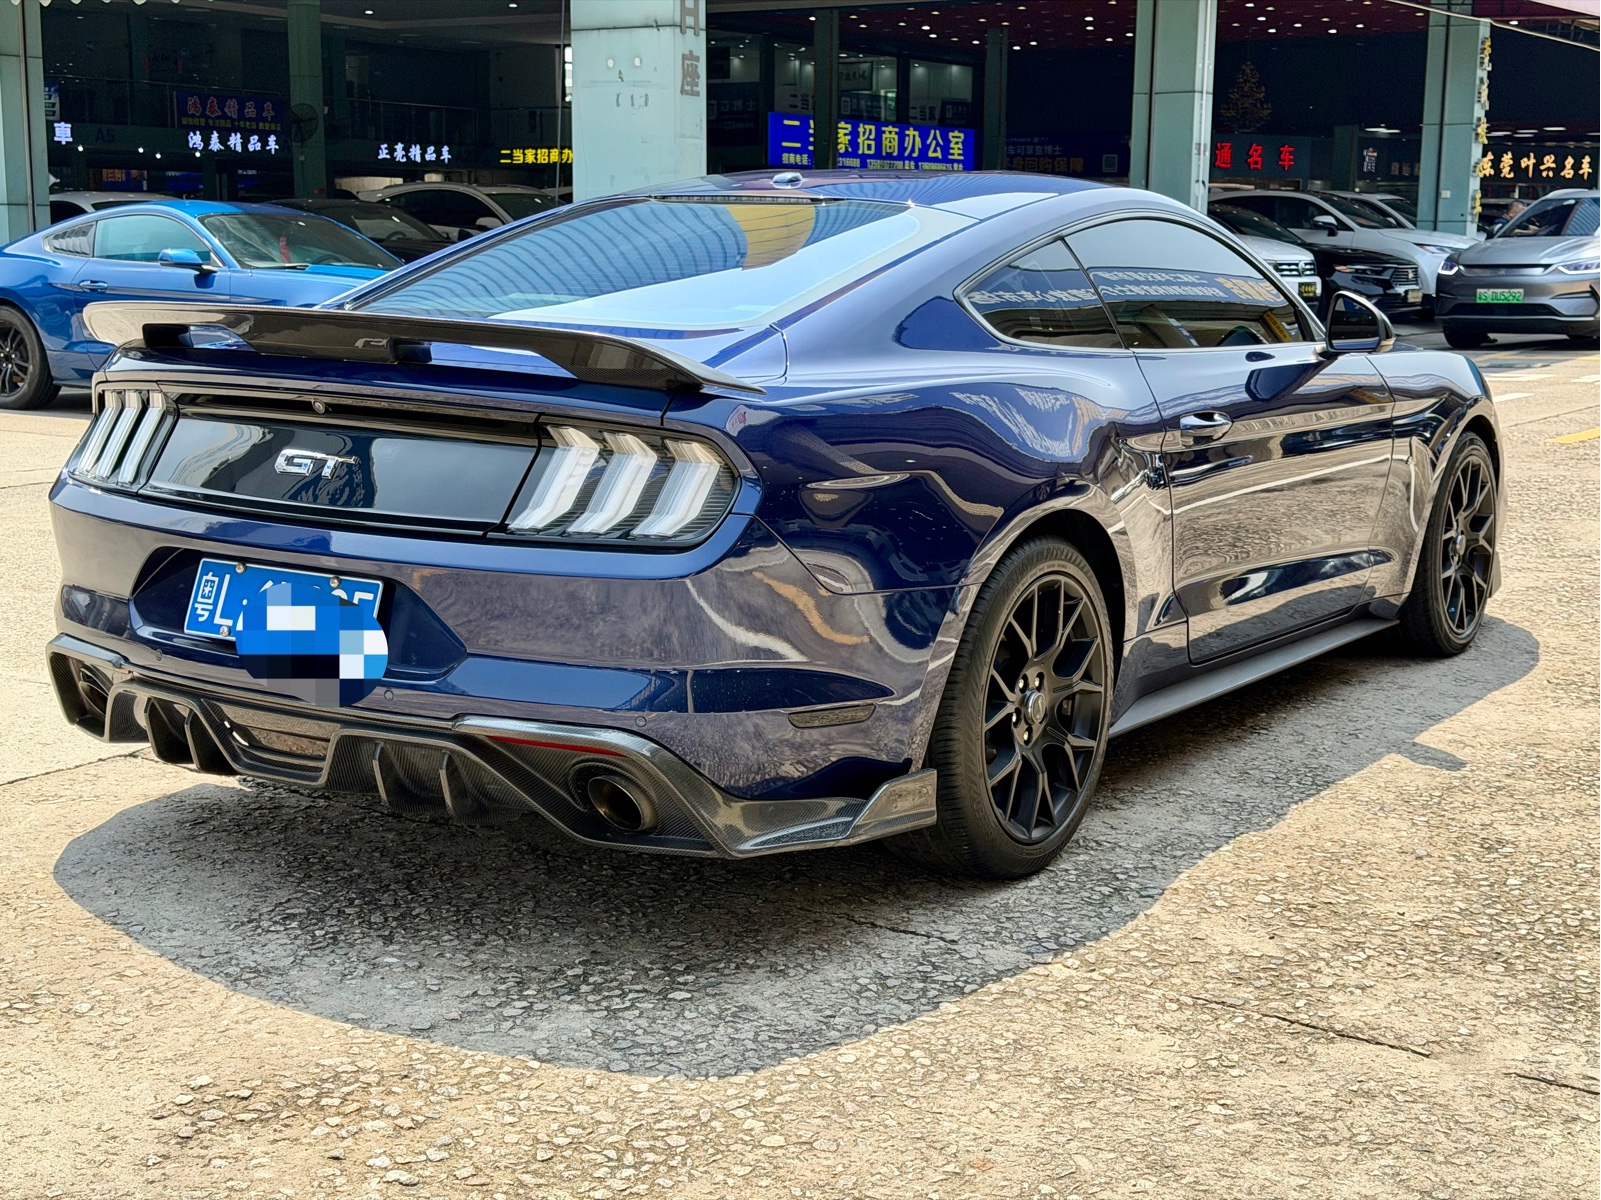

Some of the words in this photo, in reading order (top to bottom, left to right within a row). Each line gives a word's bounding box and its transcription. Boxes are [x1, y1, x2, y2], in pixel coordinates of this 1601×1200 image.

[187, 96, 276, 121] 鸿泰精品车
[187, 130, 280, 155] 鸿泰精品车
[377, 142, 452, 165] 正亮精品车
[1005, 145, 1063, 156] 车可享查博士
[500, 147, 574, 165] 二当家招商办
[1214, 142, 1295, 171] 通名车
[274, 448, 360, 480] GT
